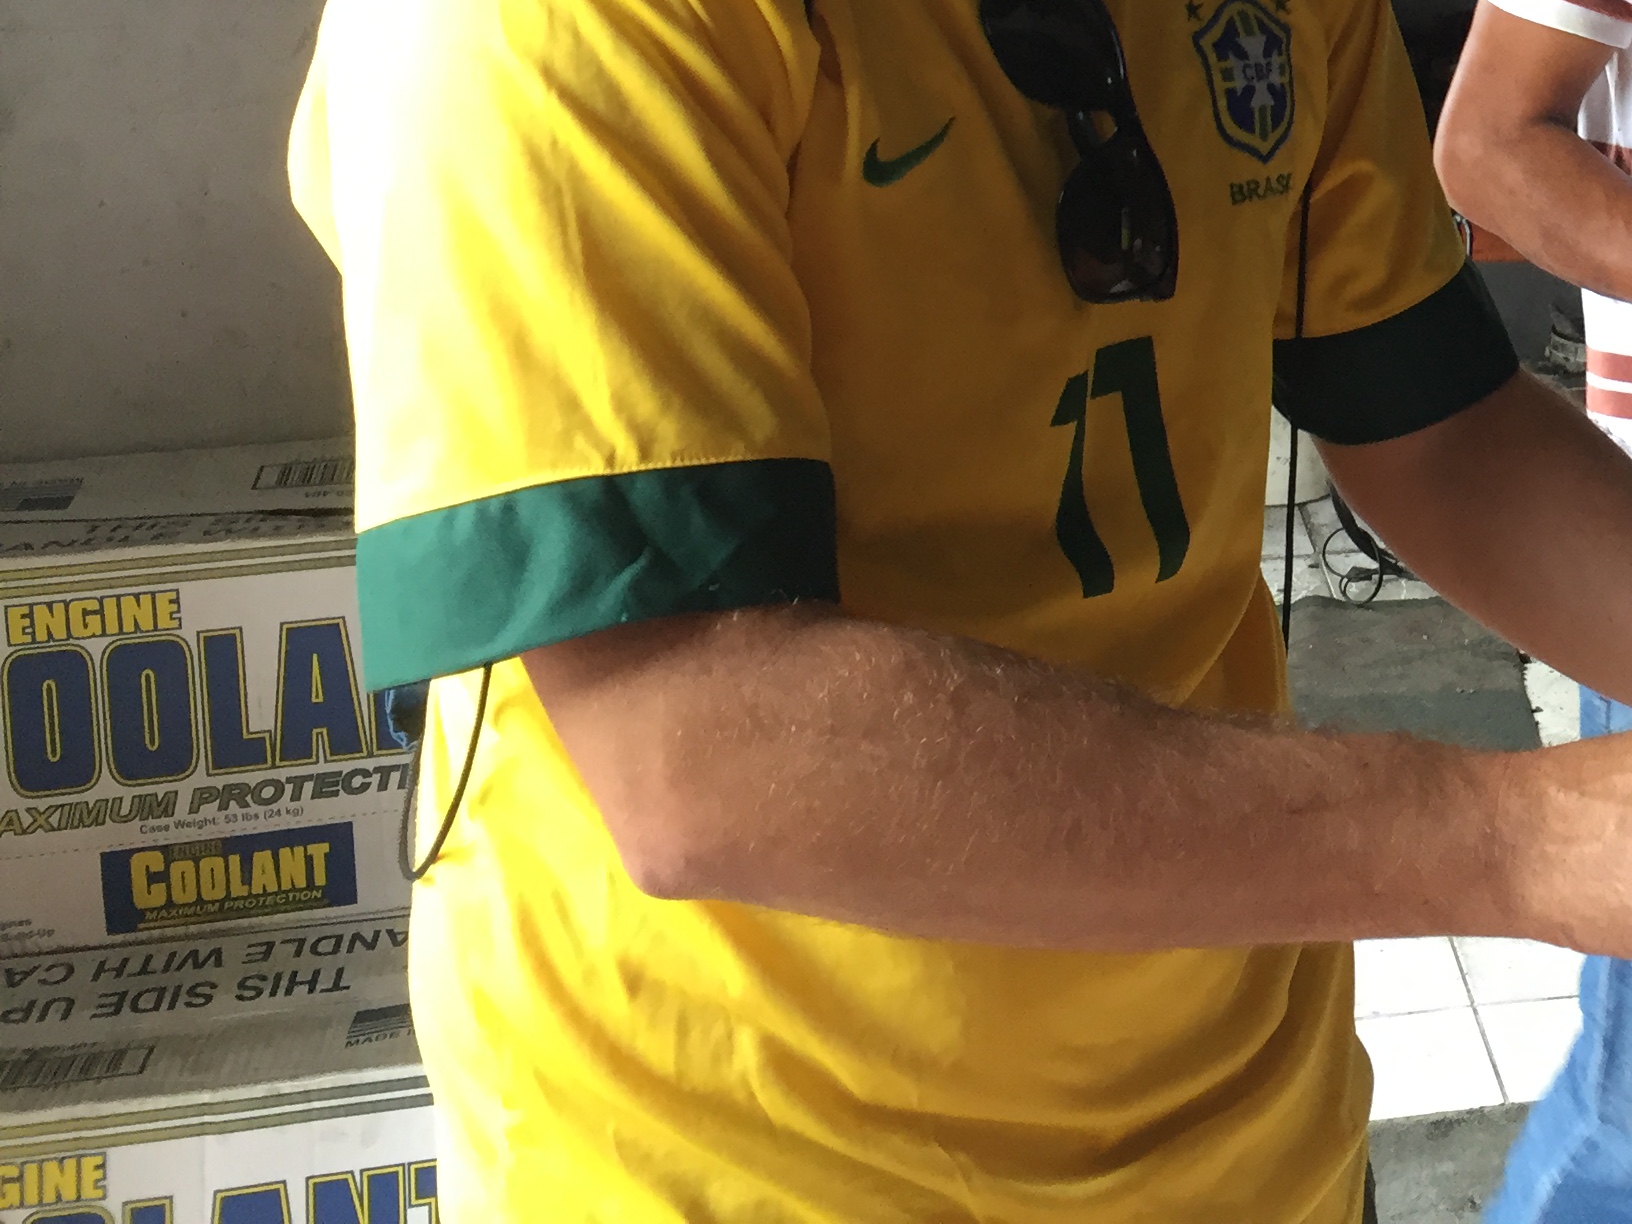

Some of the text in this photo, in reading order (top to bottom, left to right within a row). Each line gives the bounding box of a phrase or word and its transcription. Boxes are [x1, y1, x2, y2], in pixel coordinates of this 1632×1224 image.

[4, 588, 182, 647] ENGINE
[0, 788, 179, 838] AXIMUM
[138, 805, 305, 835] Case Weight: 53 lbs (24 kg)
[130, 841, 331, 911] COOLANT
[145, 888, 323, 921] MAXIMUM PROTECTION
[91, 946, 224, 983] WITH
[0, 966, 352, 1026] THIS SIDE UP
[344, 1030, 402, 1049] MADE
